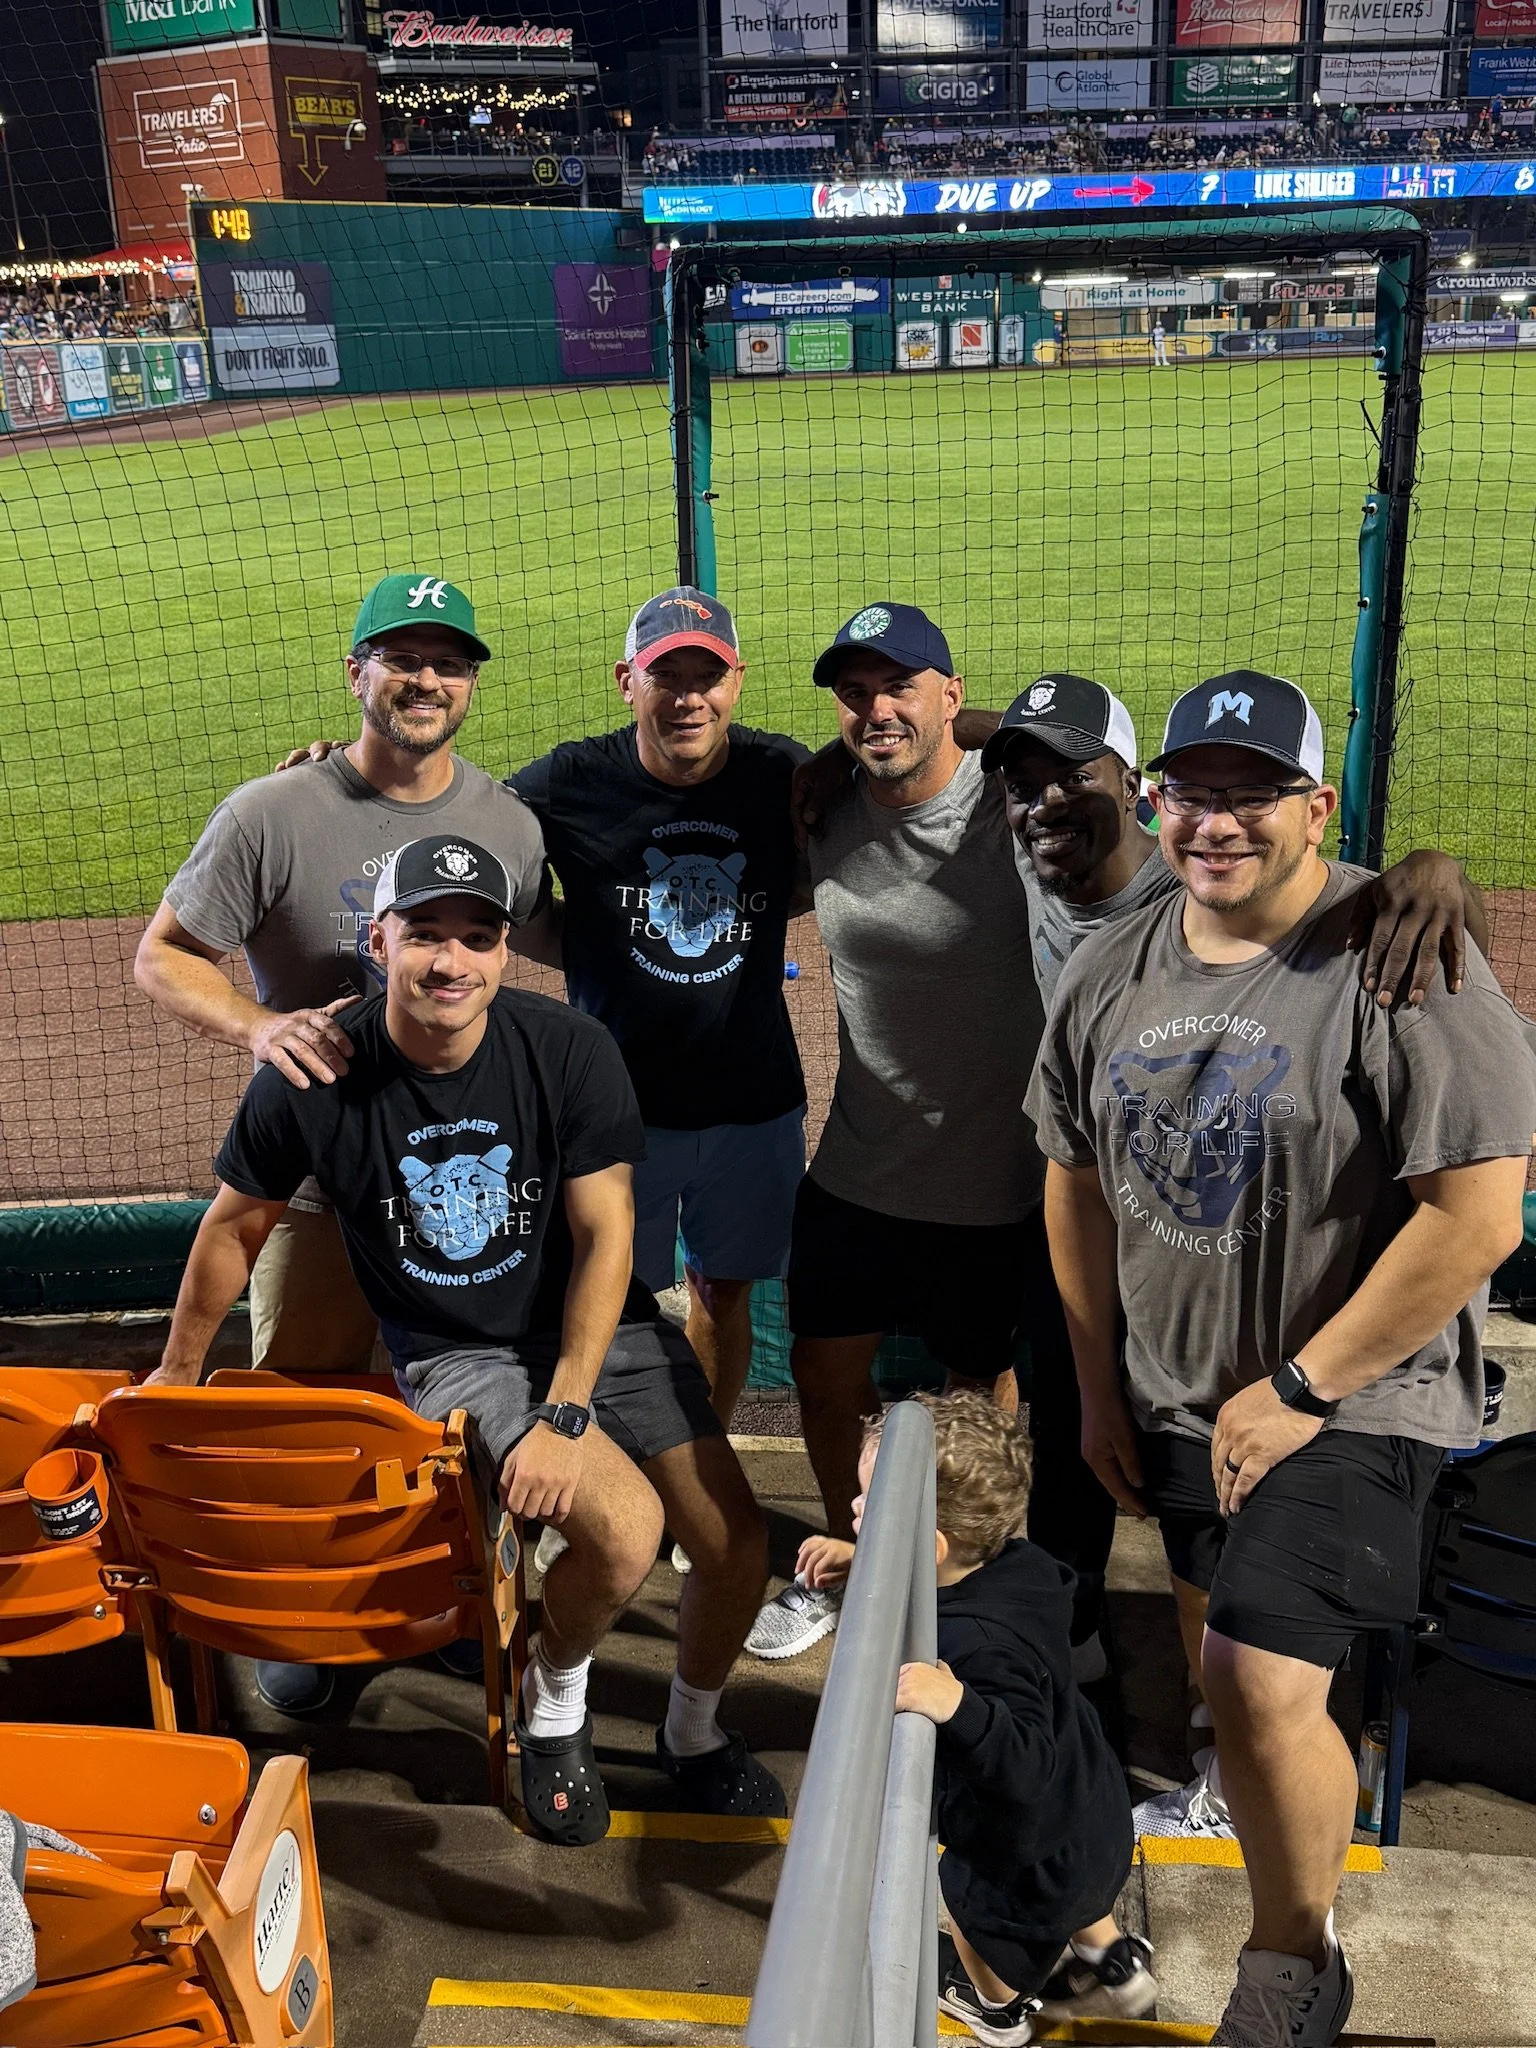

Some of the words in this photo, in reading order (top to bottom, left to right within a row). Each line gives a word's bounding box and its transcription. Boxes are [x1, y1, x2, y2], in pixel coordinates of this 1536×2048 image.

[1043, 1, 1112, 19] Hartford
[1328, 2, 1424, 20] TRAVELERS
[383, 9, 573, 48] Budweiser
[731, 14, 763, 31] The
[767, 13, 838, 32] Hartford
[1043, 22, 1134, 37] HealthCare
[1325, 59, 1343, 69] Life
[1479, 57, 1508, 68] Frank
[1076, 70, 1112, 80] Global
[1077, 83, 1120, 93] Atlantic
[294, 95, 357, 117] BEAR'S
[142, 106, 218, 131] TRAVELERS
[174, 135, 208, 155] Patio
[935, 182, 998, 213] DUE
[1009, 179, 1051, 210] UP
[1201, 174, 1220, 201] 7
[231, 269, 297, 293] TRANTOLO
[1435, 272, 1536, 289] Groundworks
[896, 289, 994, 302] WESTFIELD
[1086, 289, 1124, 301] Right
[1128, 288, 1143, 298] at
[1148, 288, 1186, 298] Home
[795, 305, 811, 315] GET
[812, 305, 825, 314] TO
[921, 302, 968, 313] BANK
[262, 347, 295, 369] FIGHT
[297, 346, 330, 369] SOLO.
[1204, 689, 1254, 730] M
[652, 820, 740, 843] OVERCOMER
[433, 844, 478, 865] OVERCOMER
[615, 885, 768, 914] TRAINING
[629, 917, 689, 942] FOR
[699, 921, 753, 943] LIFE
[630, 947, 690, 984] TRAINING
[692, 953, 745, 984] CENTER
[1138, 1013, 1267, 1049] OVERCOMER
[1098, 1092, 1297, 1120] TRAINING
[406, 1118, 500, 1146] OVERCOMER
[1109, 1128, 1193, 1157] FOR
[1200, 1129, 1293, 1157] LIFE
[429, 1174, 488, 1198] O.T.C.
[380, 1177, 543, 1222] TRAINING
[1117, 1177, 1211, 1256] TRAINING
[1216, 1185, 1293, 1256] CENTER
[397, 1224, 465, 1249] FOR
[473, 1211, 533, 1241] LIFE
[400, 1257, 470, 1287] TRAINING
[472, 1248, 528, 1285] CENTER
[294, 1978, 312, 2013] B
